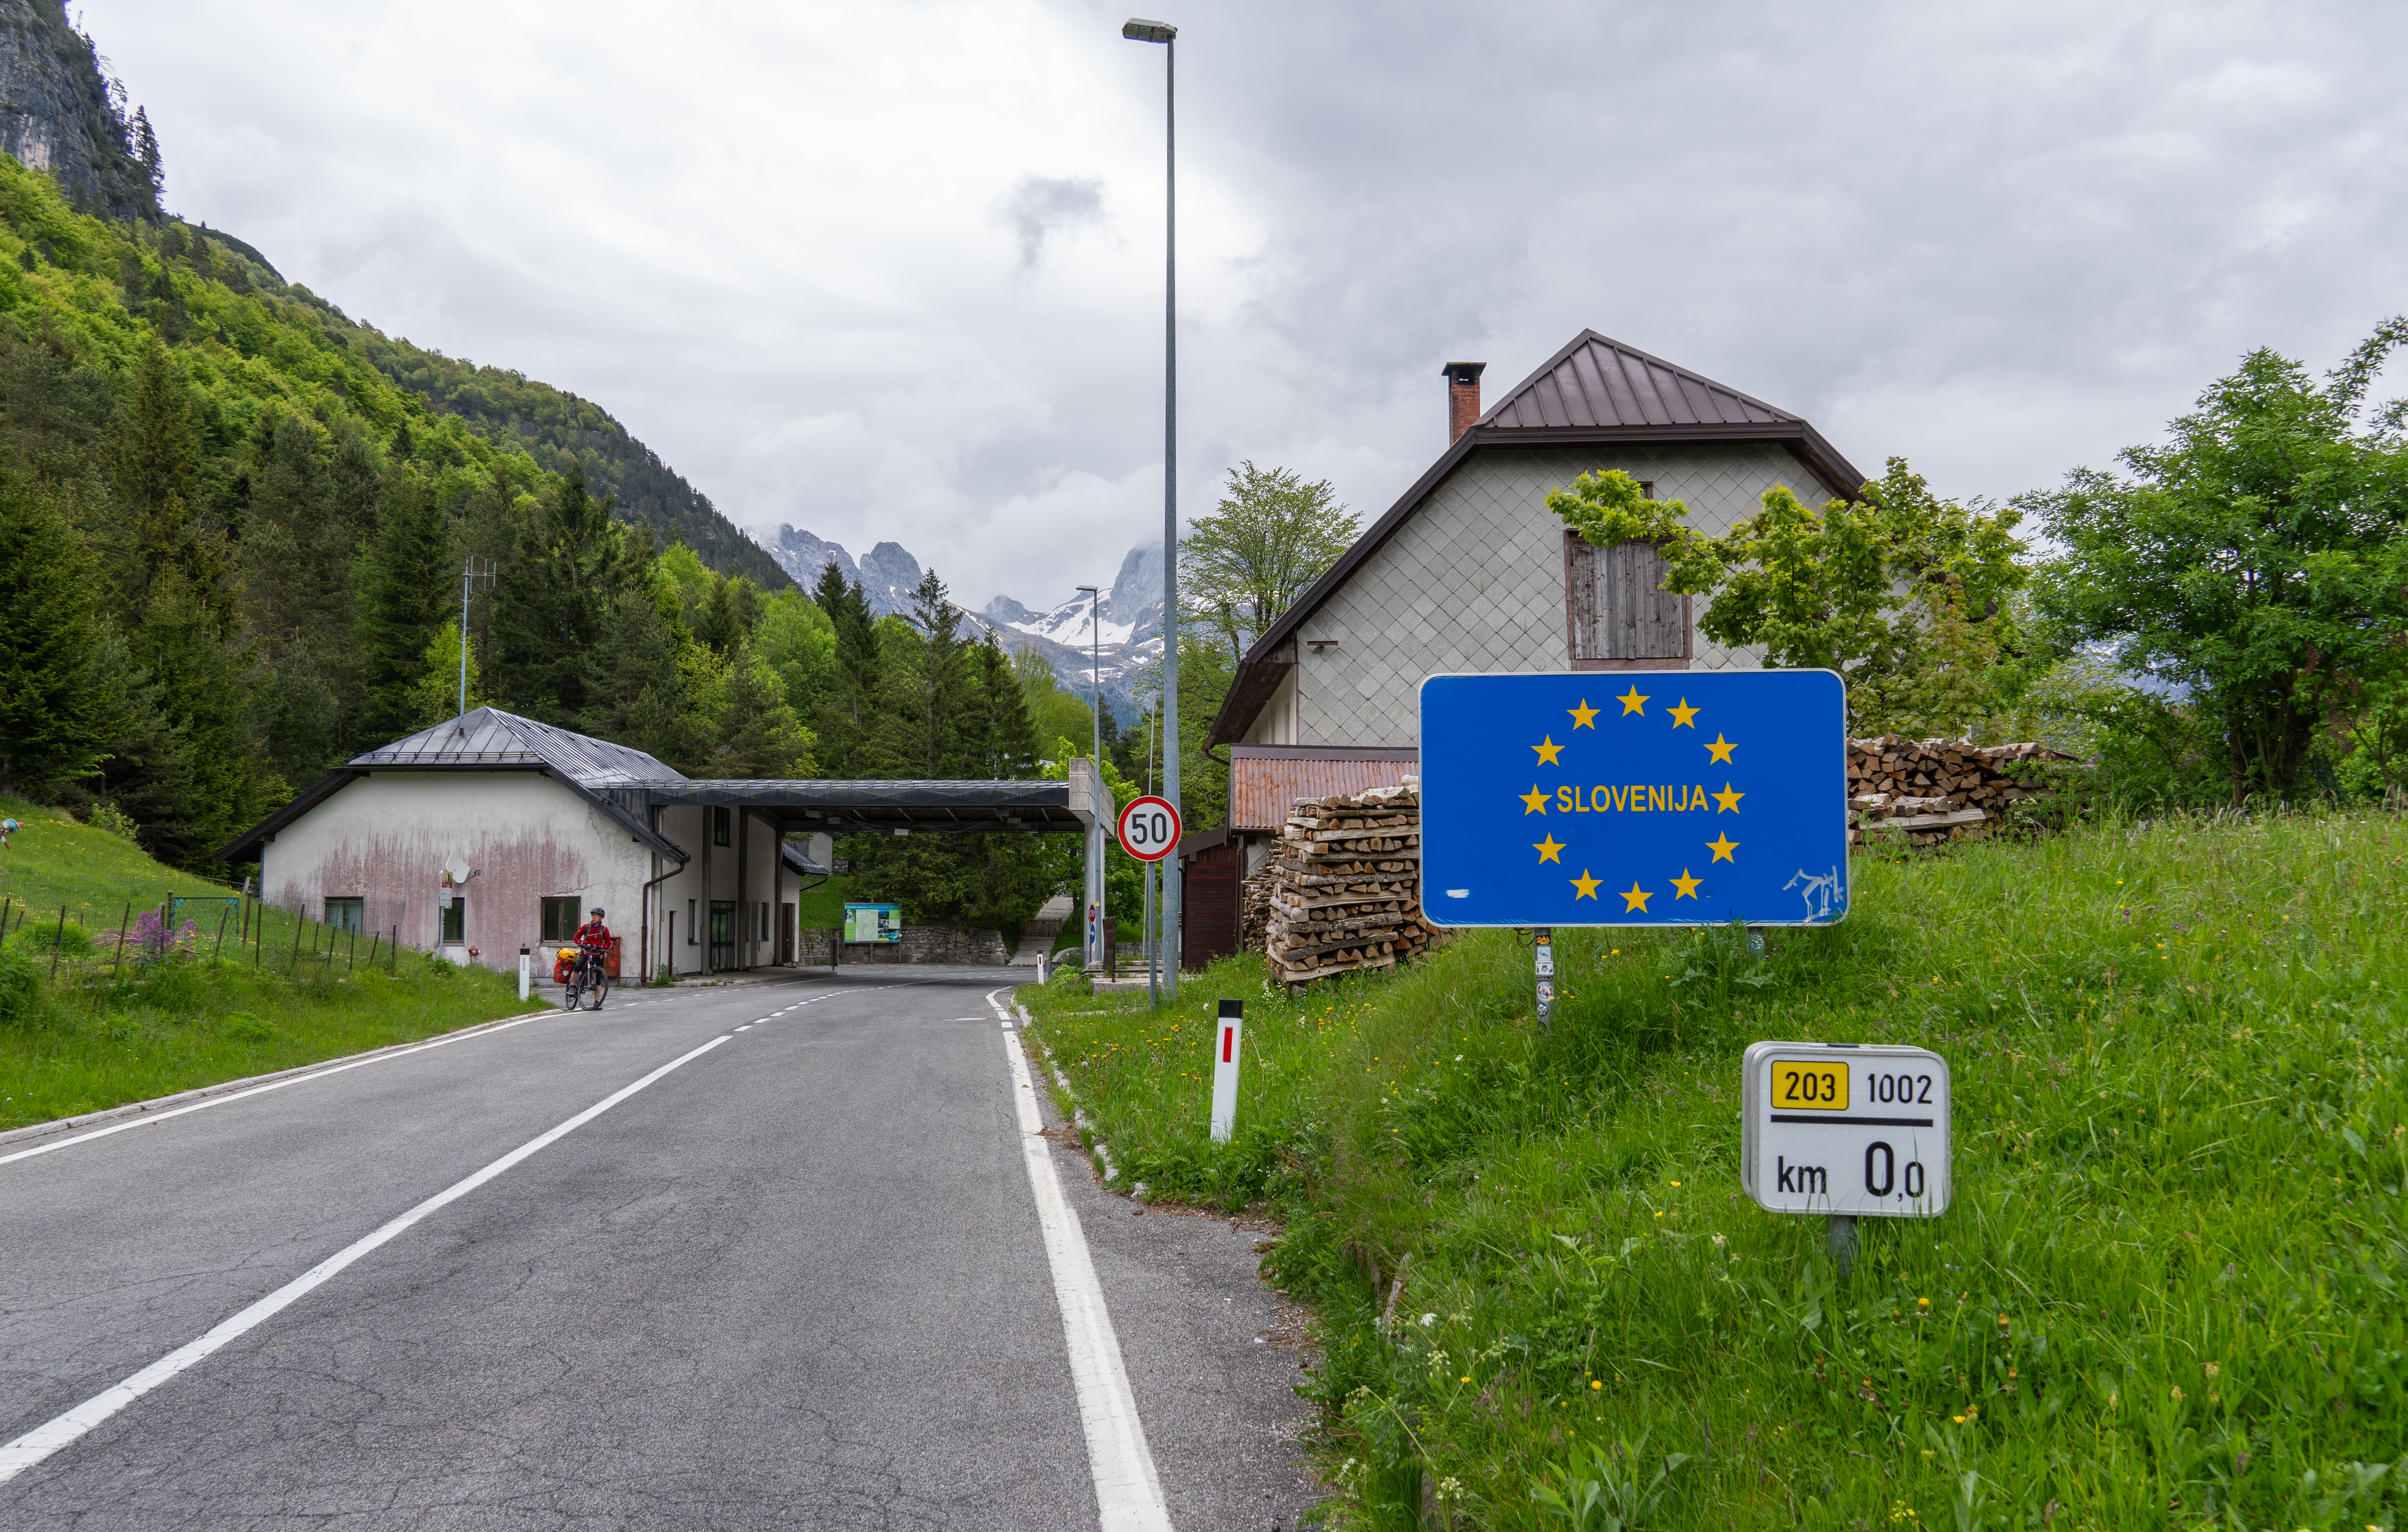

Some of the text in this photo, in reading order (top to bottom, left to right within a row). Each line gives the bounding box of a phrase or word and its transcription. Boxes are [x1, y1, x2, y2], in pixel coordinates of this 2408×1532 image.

[1557, 785, 1709, 812] SLOVENIJA
[1132, 812, 1167, 844] 50
[1785, 1072, 1932, 1104] 203 1002
[1778, 1141, 1924, 1201] km 0,0
